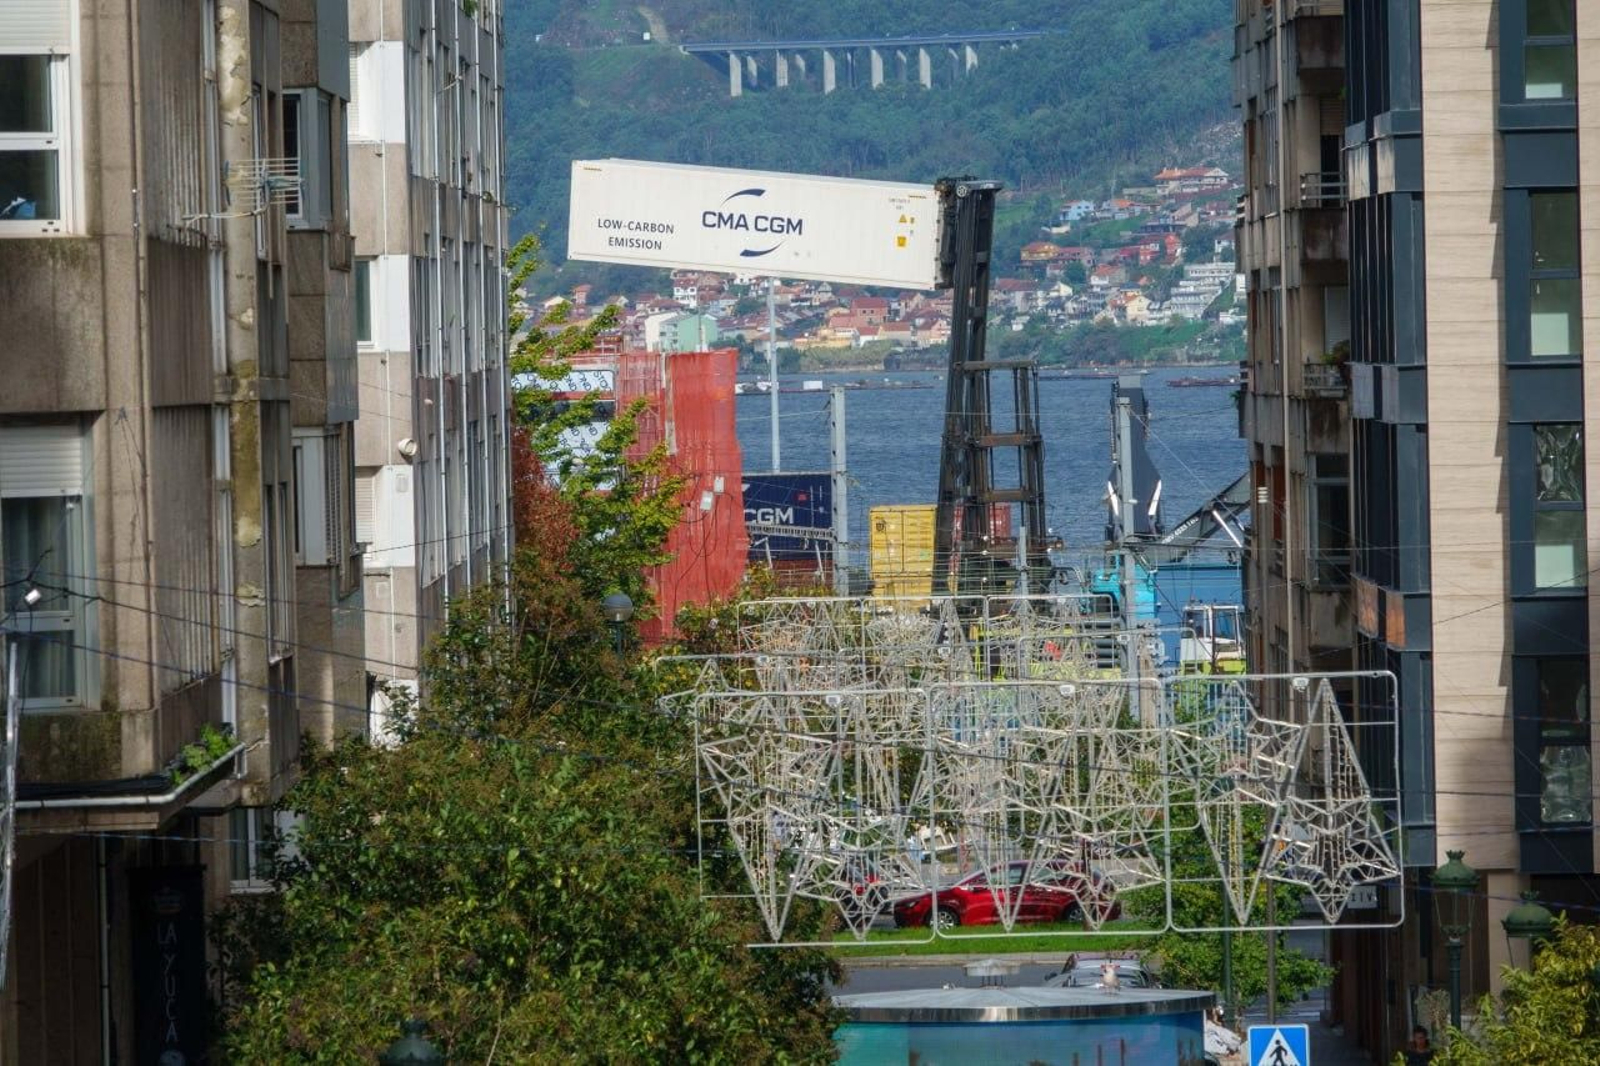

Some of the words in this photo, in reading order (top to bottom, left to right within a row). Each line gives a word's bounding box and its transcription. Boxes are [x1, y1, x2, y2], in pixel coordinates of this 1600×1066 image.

[598, 218, 675, 235] LOW-CARBON
[702, 211, 750, 231] CMA
[754, 215, 803, 236] CGM
[608, 236, 662, 250] EMISSION
[743, 506, 795, 526] CGM
[157, 921, 178, 945] LA
[163, 953, 179, 1043] YUCA
